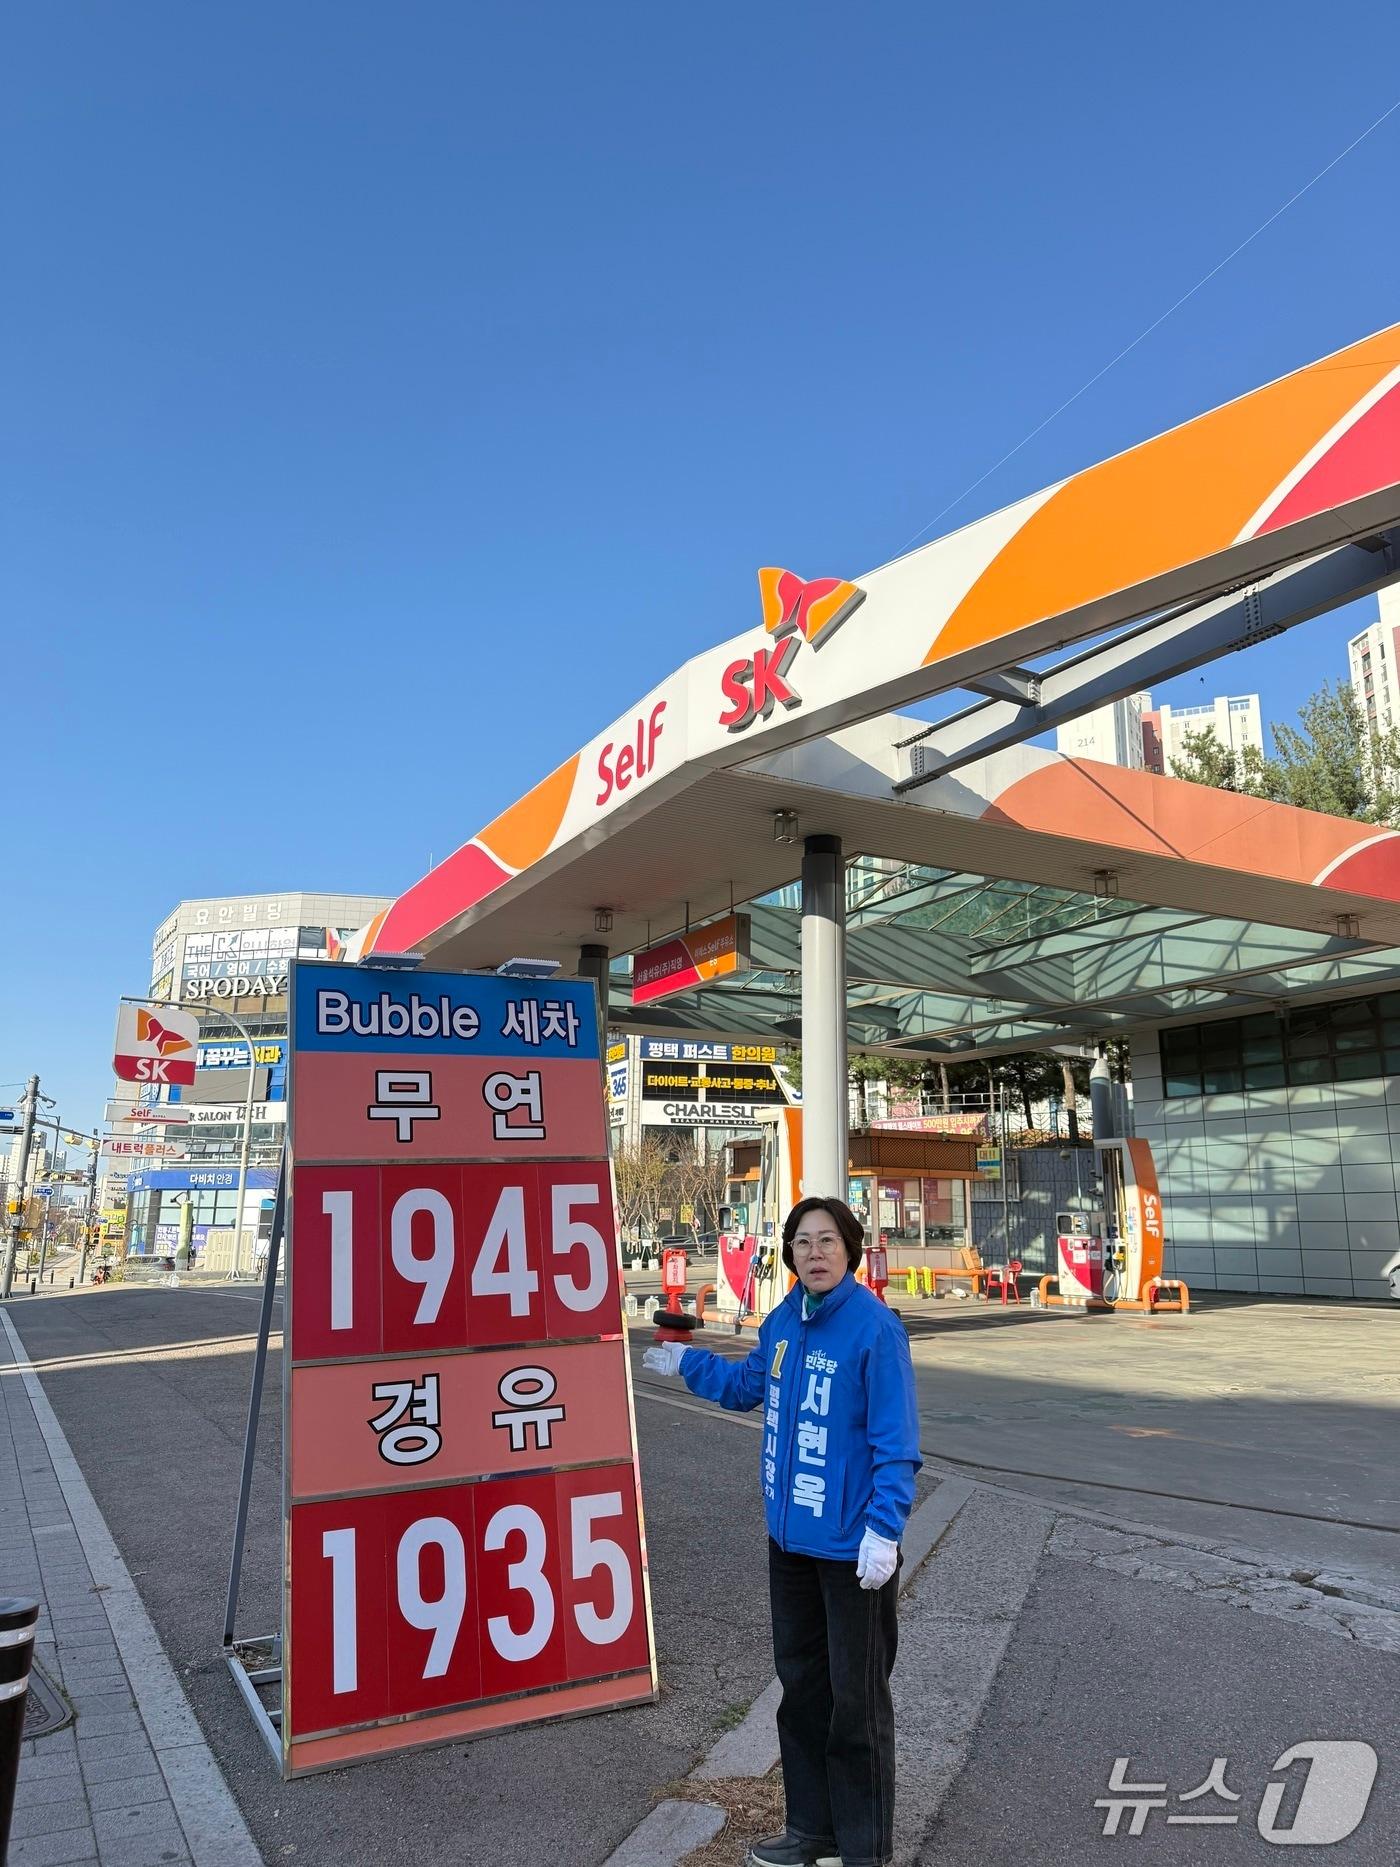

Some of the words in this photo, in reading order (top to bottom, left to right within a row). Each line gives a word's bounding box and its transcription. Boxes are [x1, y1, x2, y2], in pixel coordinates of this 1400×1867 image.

[719, 636, 799, 730] SK
[596, 701, 667, 806] Self
[1077, 735, 1095, 748] 214
[187, 944, 212, 959] THE
[187, 964, 210, 978] 국어
[227, 962, 250, 977] 영어
[186, 975, 288, 999] SPODAY
[317, 989, 480, 1039] Bubble
[502, 999, 580, 1047] 세차
[206, 1047, 249, 1066] 꿈꾸는
[648, 1043, 678, 1059] 평택
[683, 1044, 728, 1060] 퍼스트
[731, 1046, 777, 1062] 한의원
[134, 1058, 172, 1082] SK
[130, 1108, 152, 1118] Self
[198, 1111, 232, 1122] SALON
[1143, 1193, 1160, 1239] Self
[322, 1184, 608, 1330] 1945
[770, 1339, 789, 1380] 1
[805, 1354, 838, 1375] 민주당
[793, 1373, 832, 1518] 서현옥
[322, 1491, 634, 1695] 1935
